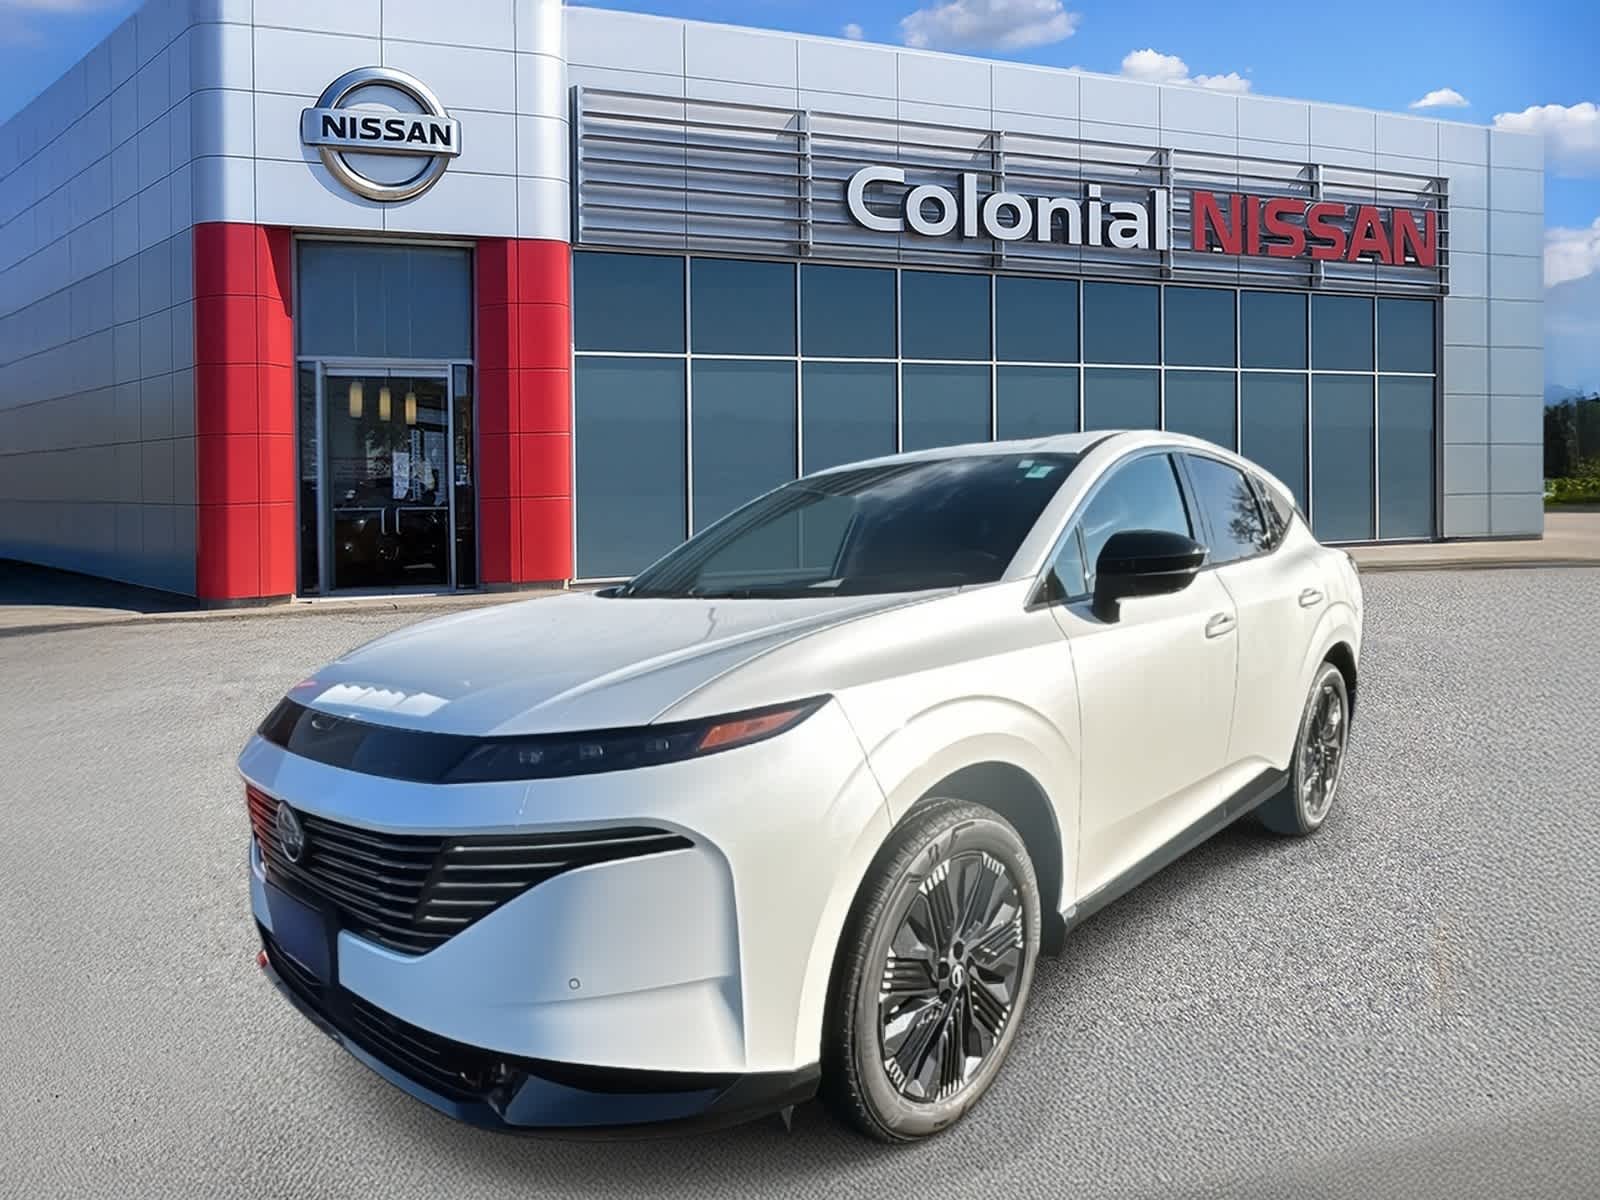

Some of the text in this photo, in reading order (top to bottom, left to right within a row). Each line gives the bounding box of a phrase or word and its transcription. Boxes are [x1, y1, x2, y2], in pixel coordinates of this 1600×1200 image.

[322, 115, 451, 146] NISSAN
[847, 165, 1437, 267] Colonial NISSAN
